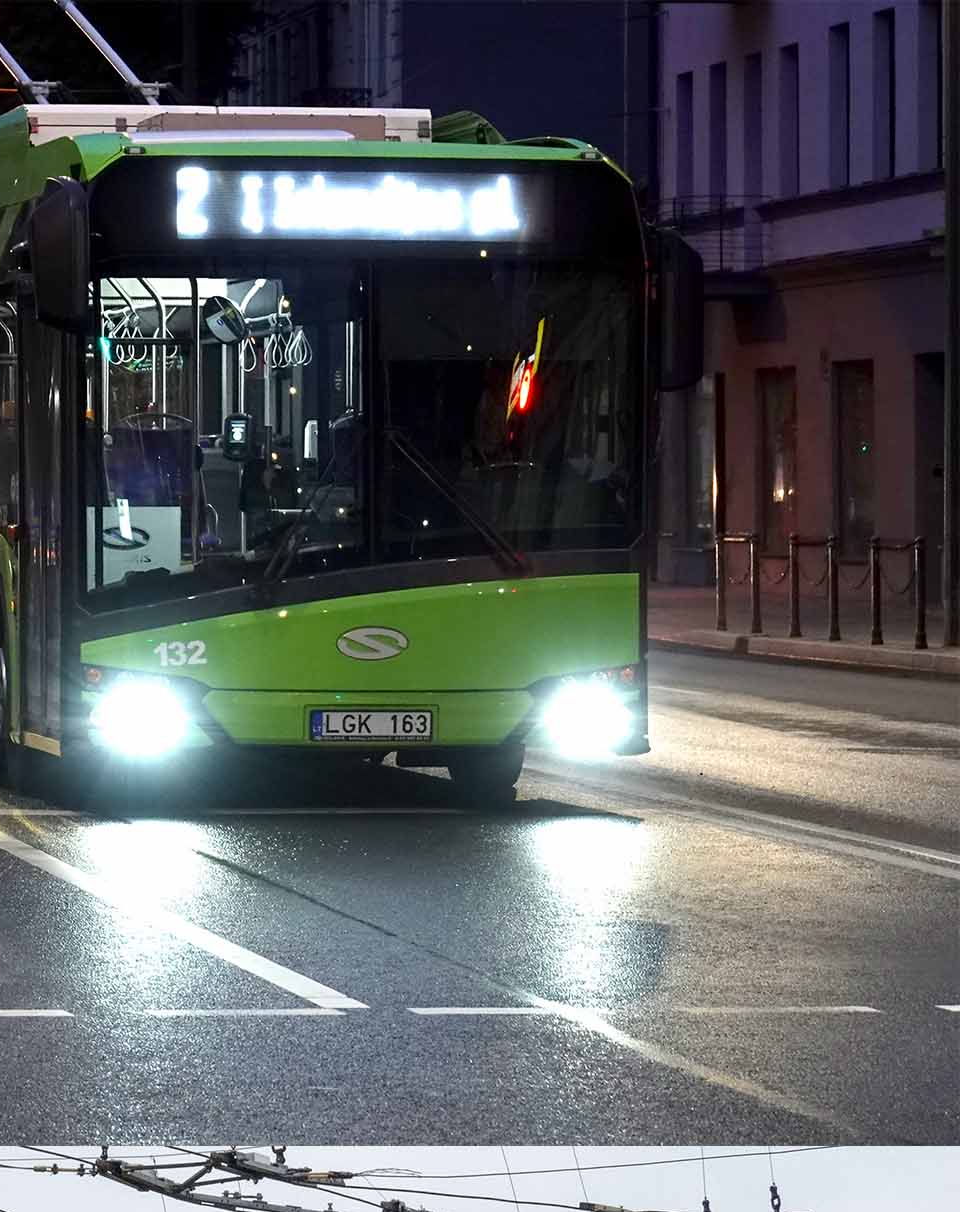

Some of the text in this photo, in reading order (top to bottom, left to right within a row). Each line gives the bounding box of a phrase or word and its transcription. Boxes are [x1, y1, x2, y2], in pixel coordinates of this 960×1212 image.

[154, 640, 208, 667] 132
[325, 714, 428, 734] LGK 163
